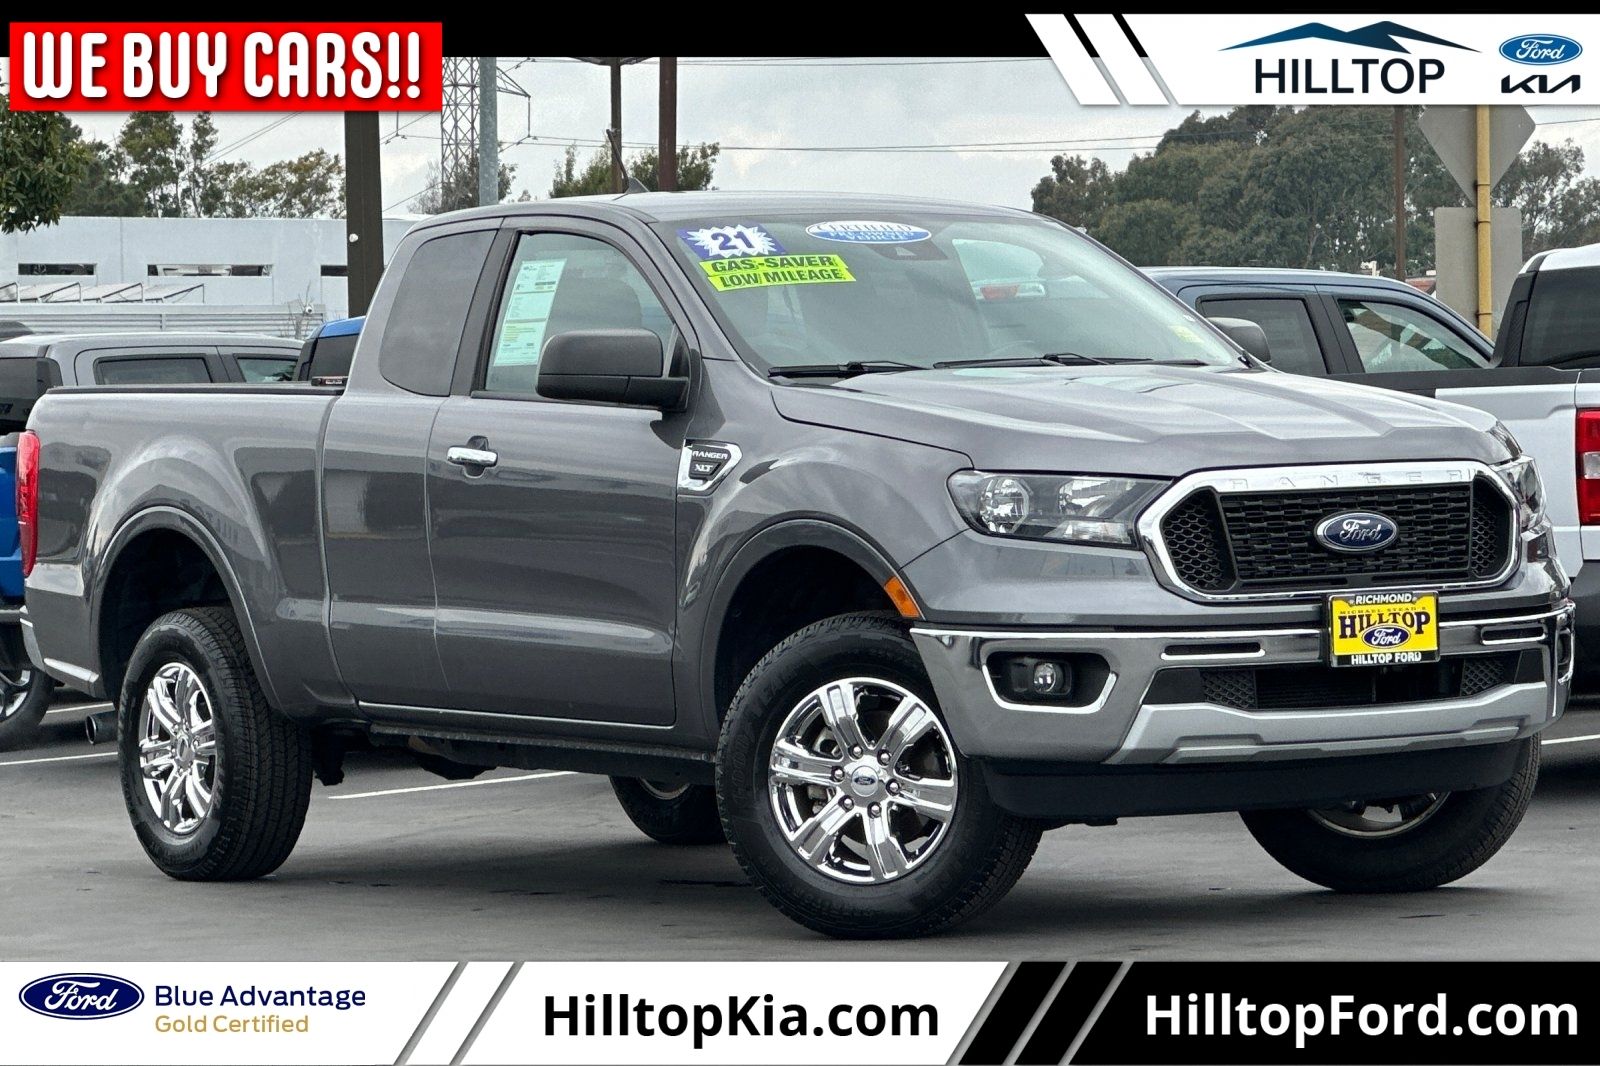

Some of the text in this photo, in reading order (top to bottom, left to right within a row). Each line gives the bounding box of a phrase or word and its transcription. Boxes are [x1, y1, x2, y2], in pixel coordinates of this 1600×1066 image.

[710, 231, 755, 251] 21
[711, 255, 834, 273] GAS-SAVER
[720, 268, 843, 288] LOW MILEAGE
[692, 450, 729, 460] RANGER
[694, 463, 714, 472] XLT
[1229, 469, 1463, 490] RANGER
[1338, 518, 1383, 542] Ford
[1355, 593, 1412, 605] RICHMOND
[1338, 611, 1431, 639] HILLTOP
[1371, 628, 1402, 645] Ford
[1351, 651, 1422, 665] HILLTOP FORD
